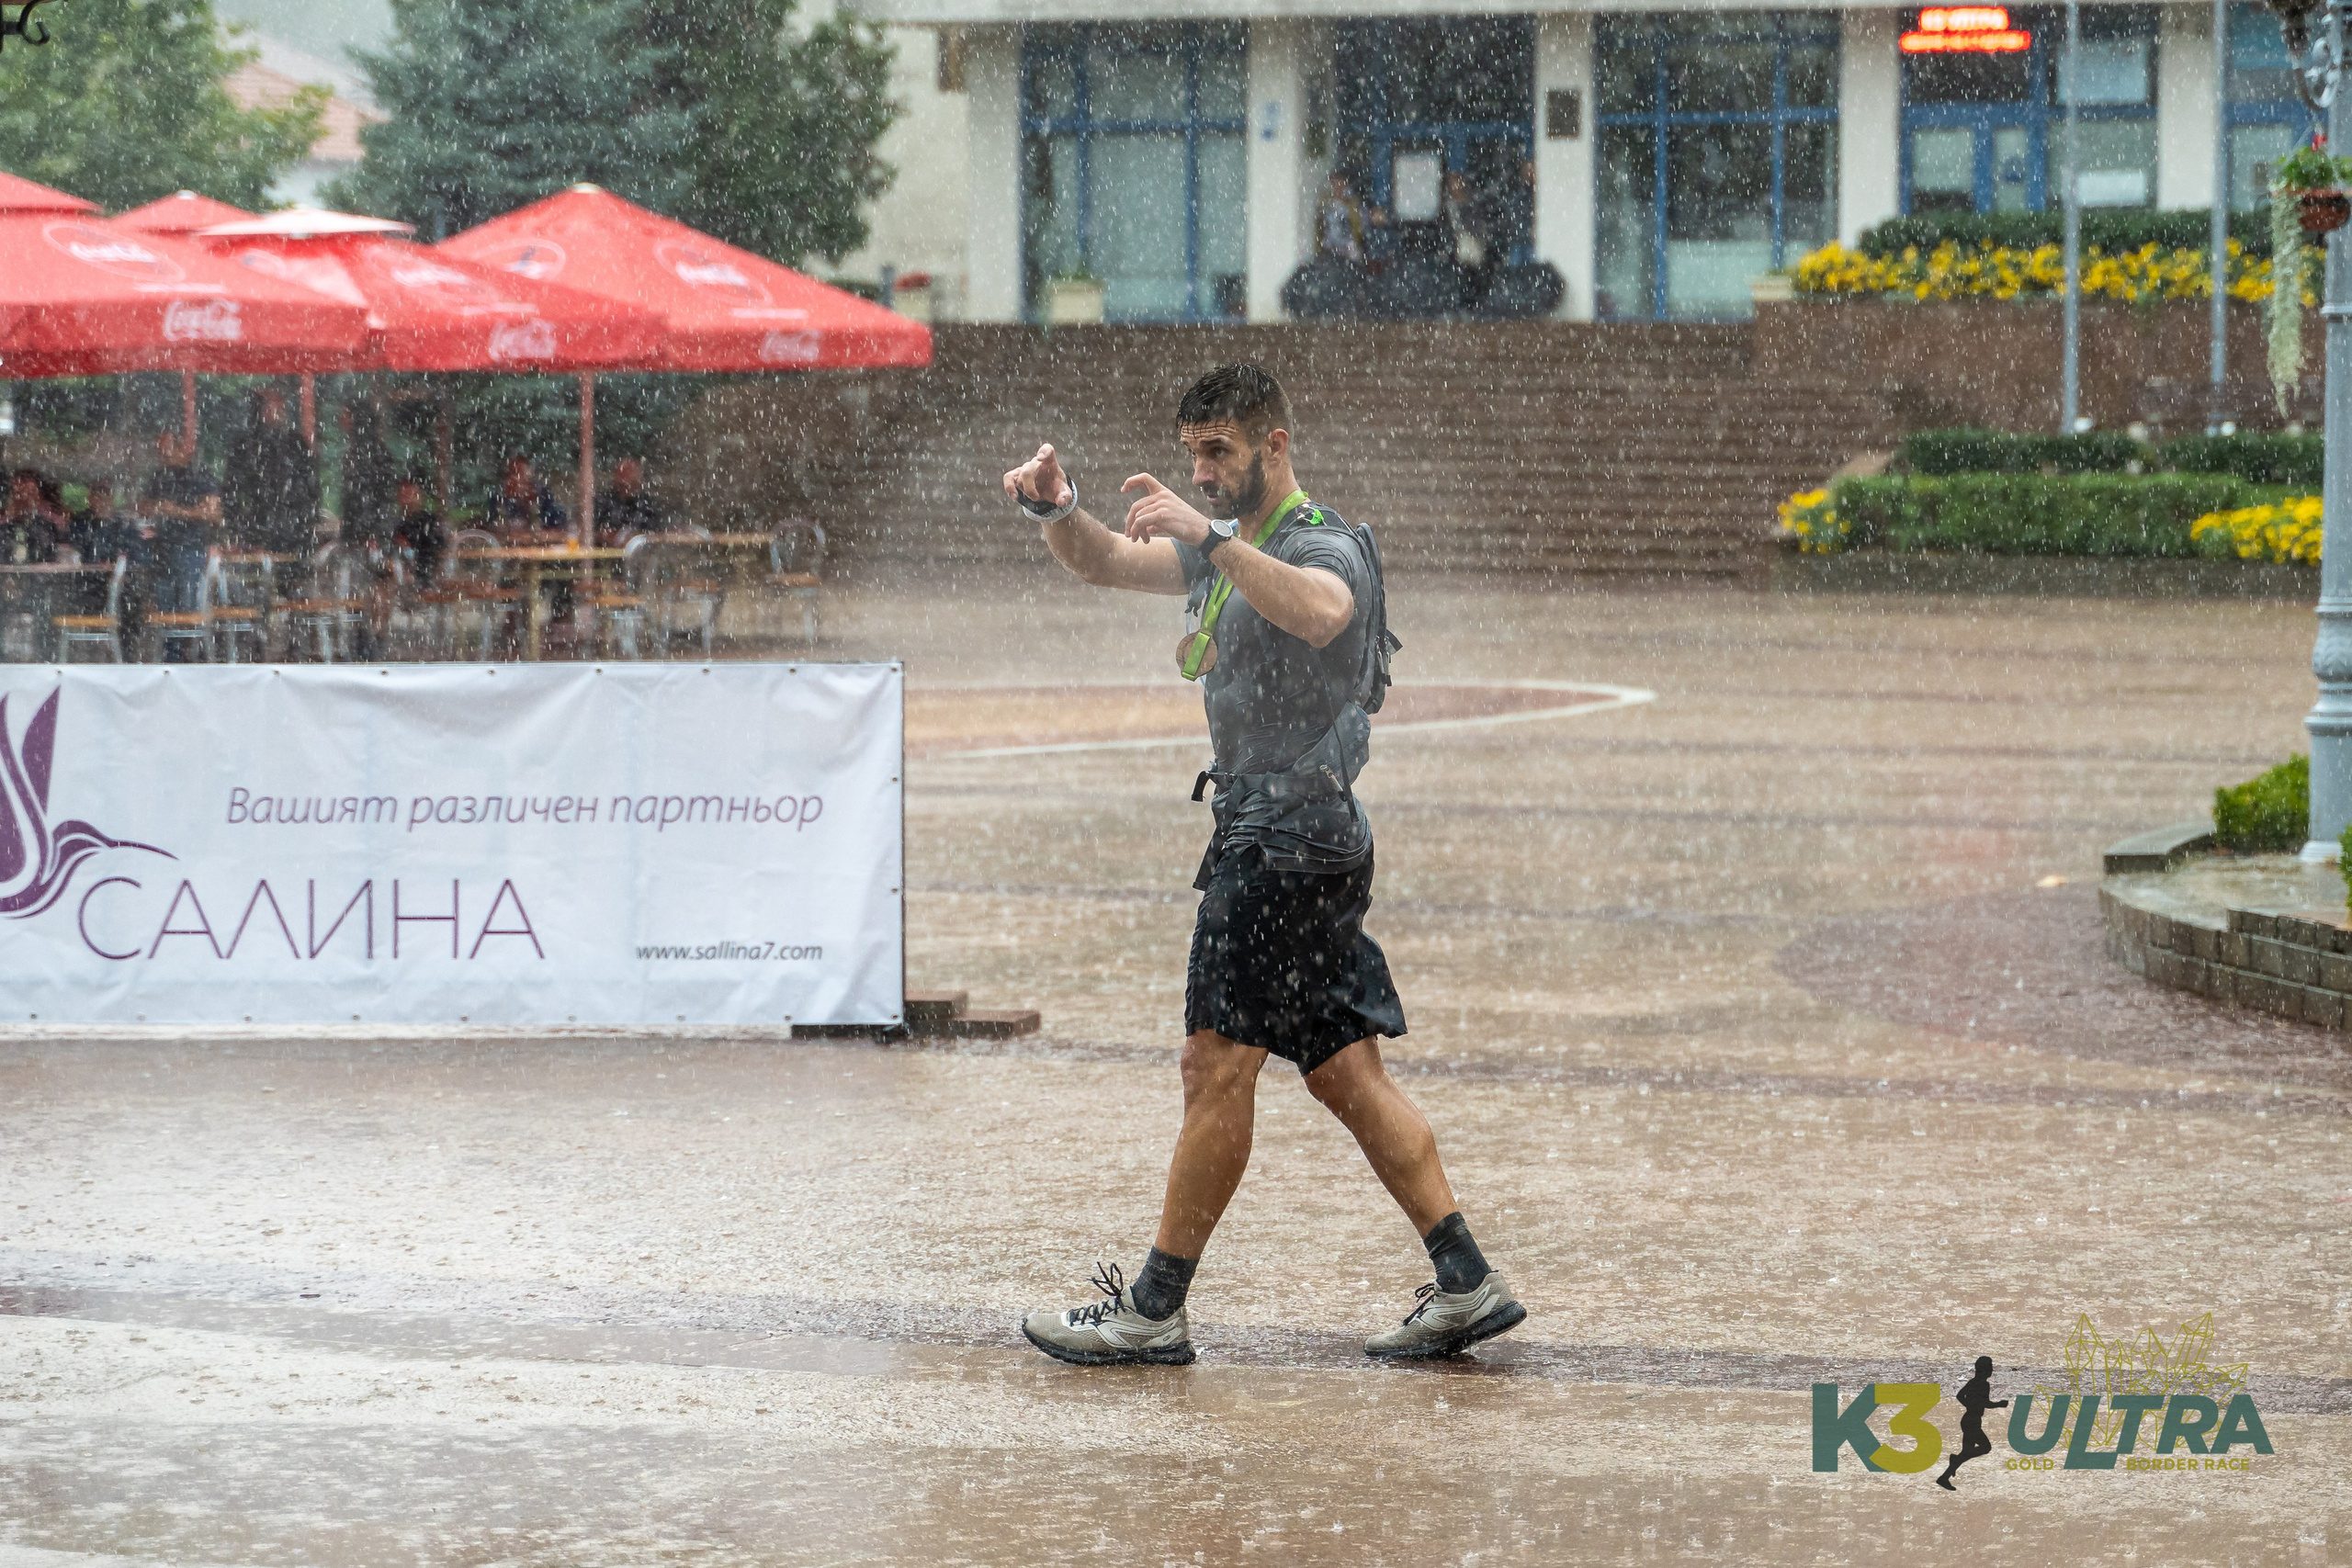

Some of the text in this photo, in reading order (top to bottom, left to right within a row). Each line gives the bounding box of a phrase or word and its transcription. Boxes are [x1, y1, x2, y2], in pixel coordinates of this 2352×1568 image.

[227, 786, 824, 832] Вашият различен партньор
[78, 875, 546, 961] САЛИНА
[635, 941, 823, 961] www.sallina7.com
